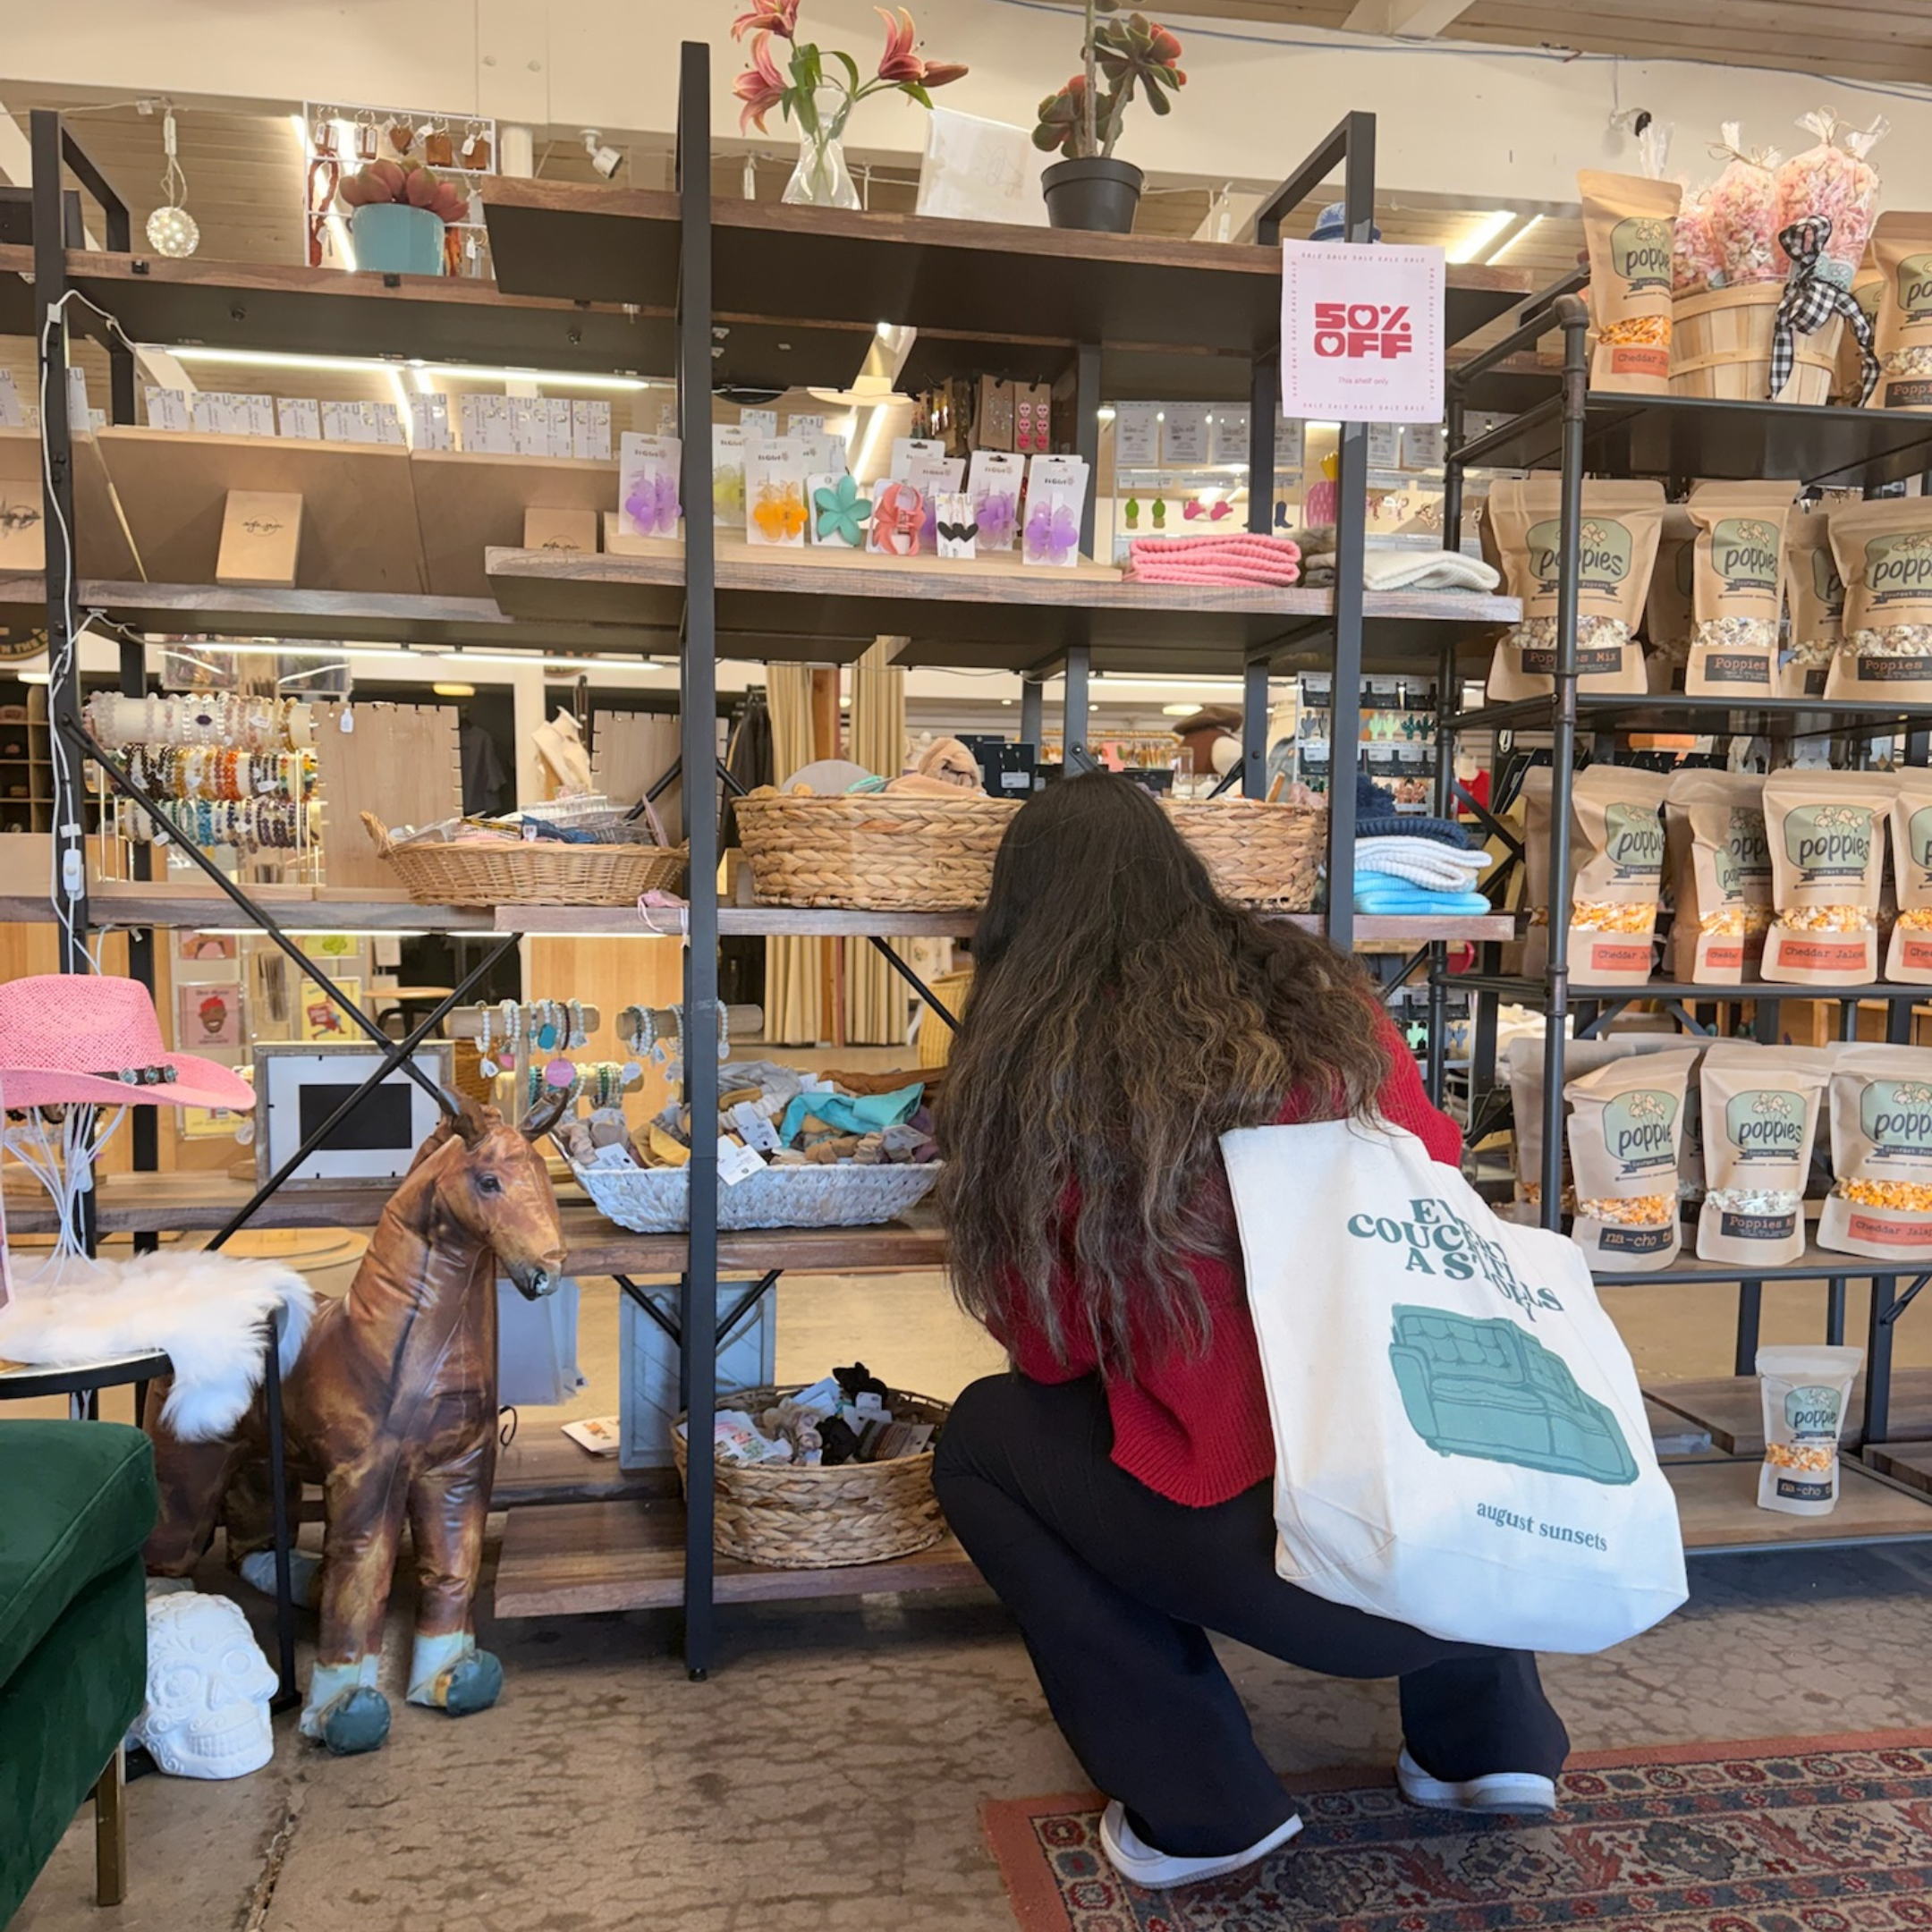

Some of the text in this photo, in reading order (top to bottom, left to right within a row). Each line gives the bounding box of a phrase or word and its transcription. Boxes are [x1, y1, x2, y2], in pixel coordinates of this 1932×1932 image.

[1315, 303, 1411, 332] 50%
[1314, 331, 1412, 359] OFF
[1618, 353, 1657, 364] Cheddar
[1338, 377, 1389, 386] This shelf only
[1539, 547, 1623, 577] ppies
[1529, 651, 1617, 665] Pops Mix
[1715, 656, 1767, 672] Poppies
[1865, 659, 1924, 673] Poppies
[1598, 949, 1637, 960] Cheddar
[1784, 945, 1831, 958] Cheddar
[1739, 1120, 1802, 1145] poppies
[1874, 1114, 1932, 1140] popp
[1729, 1216, 1783, 1230] Poppies
[1856, 1220, 1902, 1234] Cheddar
[1605, 1233, 1657, 1248] na-cho
[1781, 1482, 1821, 1496] na-cho
[1477, 1502, 1608, 1552] august sunsets
